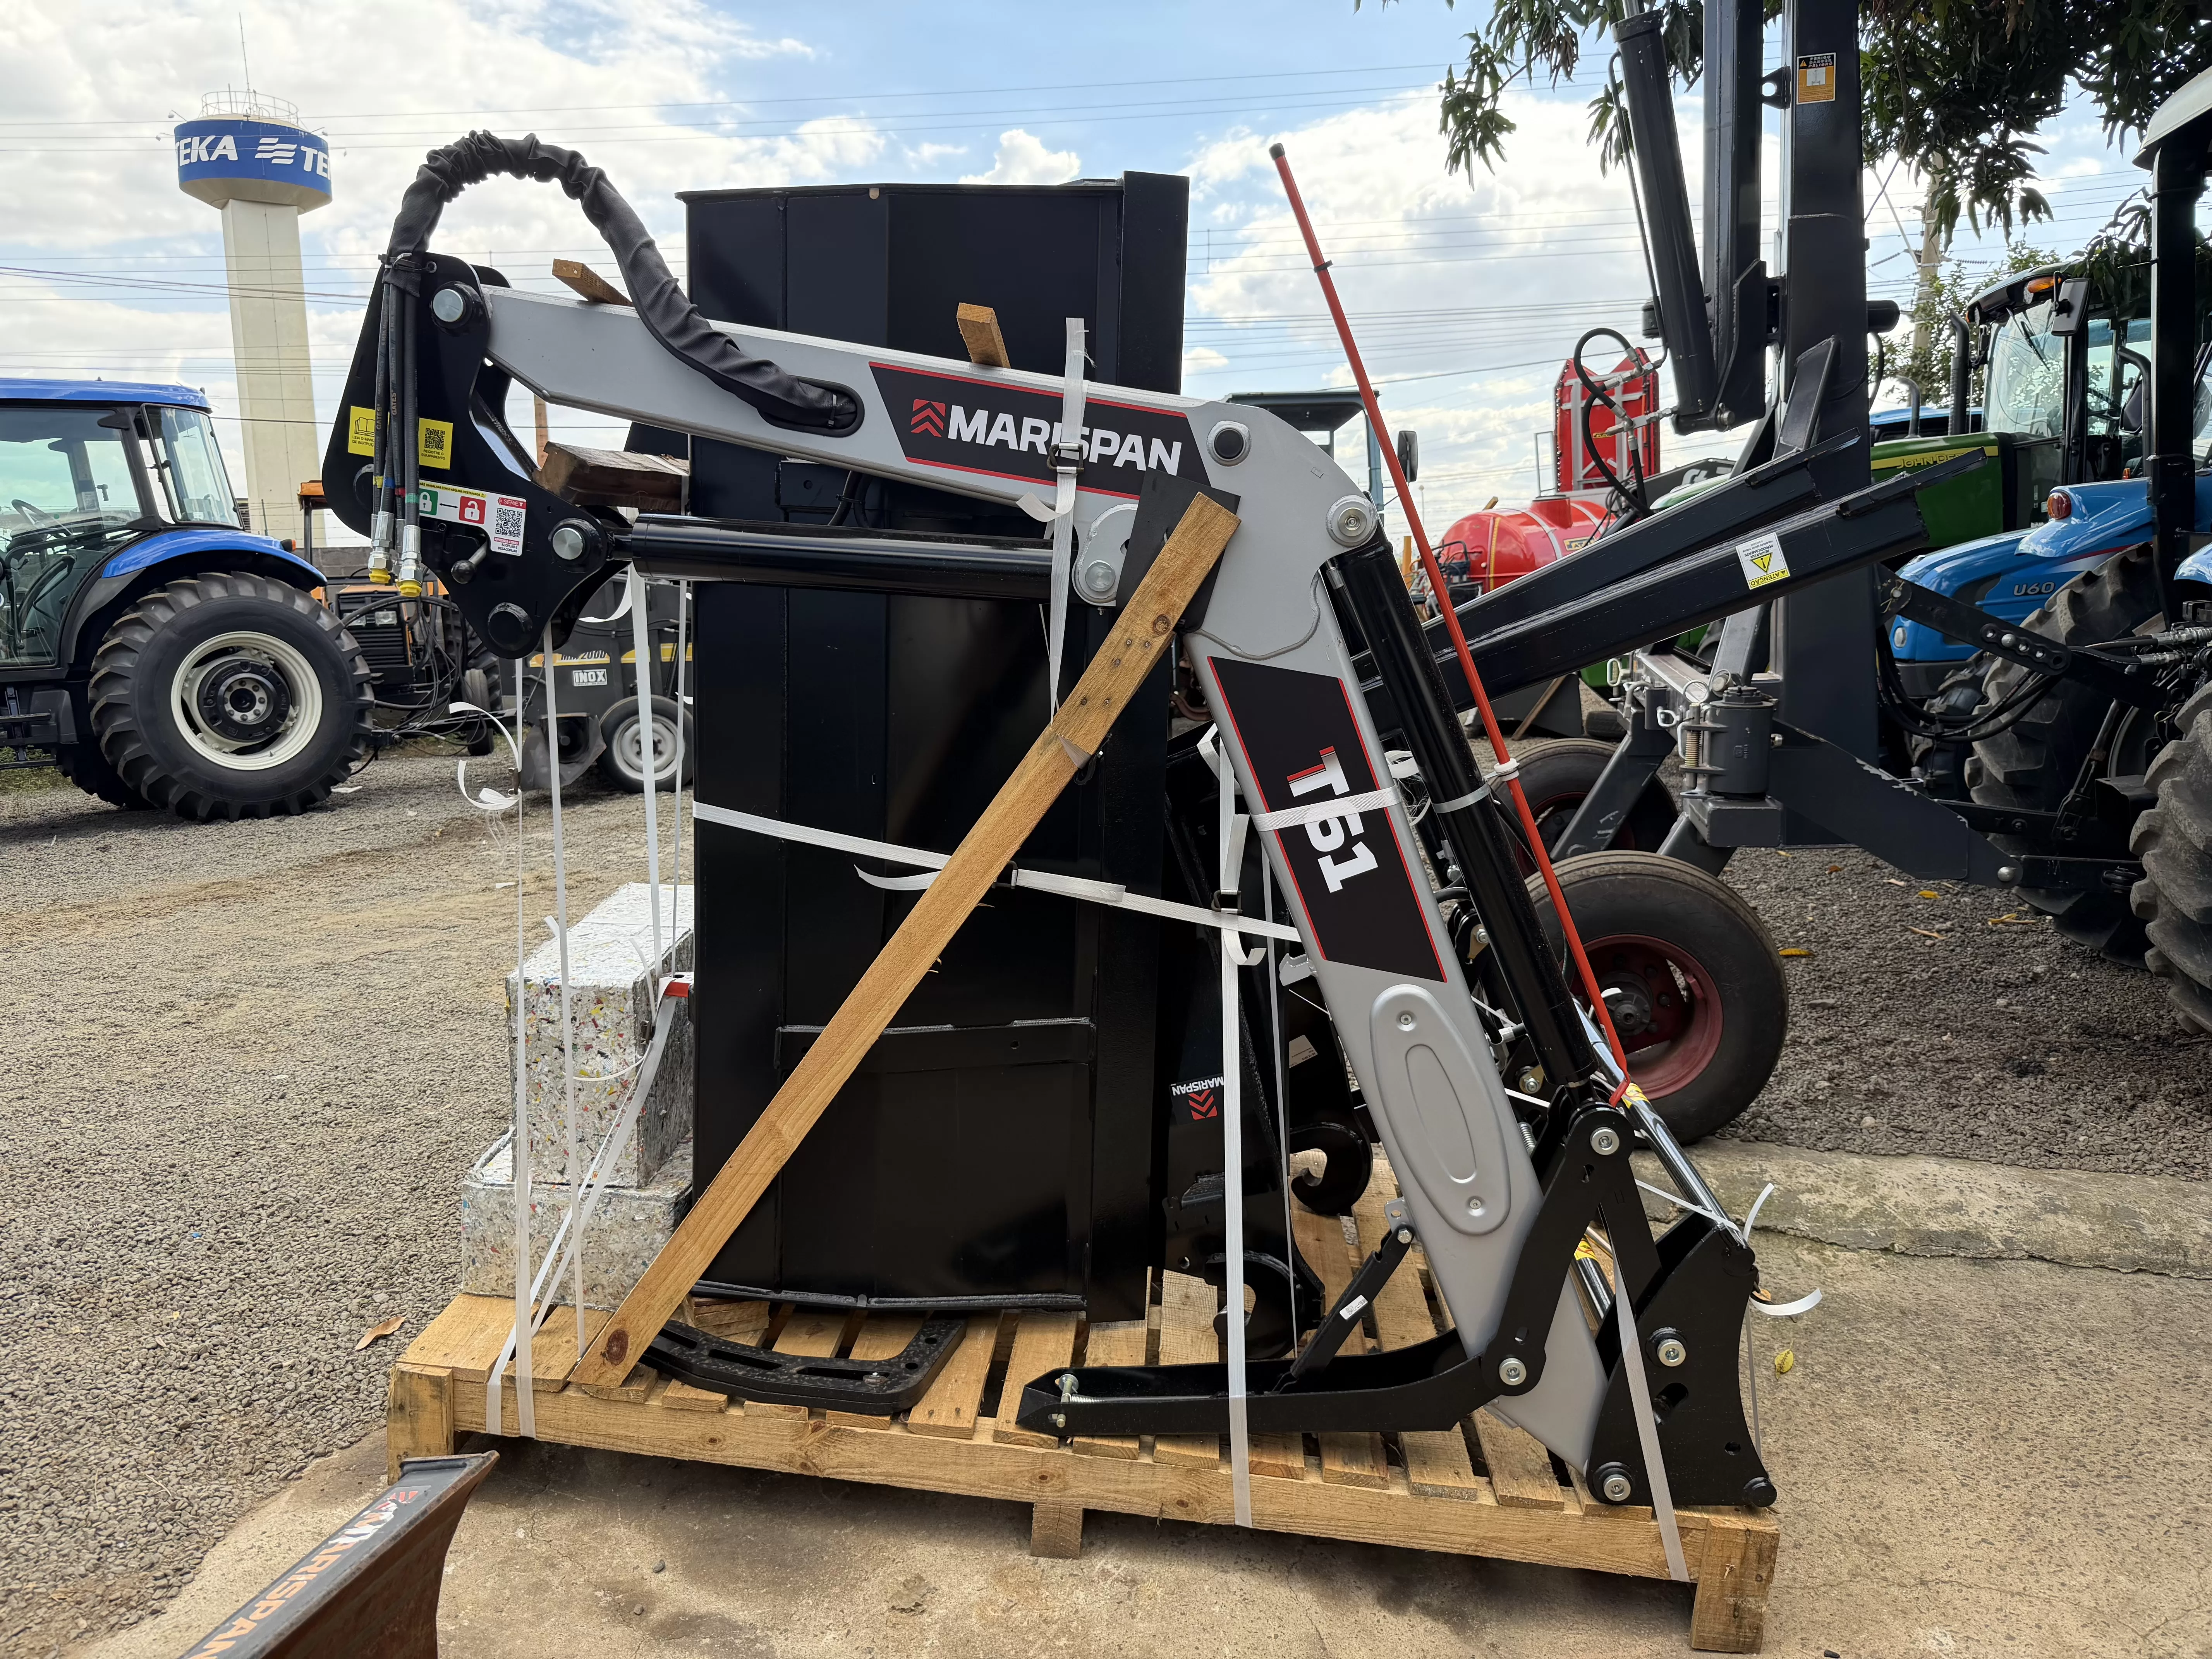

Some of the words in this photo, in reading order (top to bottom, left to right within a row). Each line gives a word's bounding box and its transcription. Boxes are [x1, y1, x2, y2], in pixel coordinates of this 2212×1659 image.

[301, 146, 330, 180] TE
[1896, 456, 1934, 469] JOHN
[2013, 582, 2055, 596] U60
[575, 671, 605, 683] INOX
[1287, 746, 1378, 893] T61
[1172, 1076, 1224, 1096] MARISPAN
